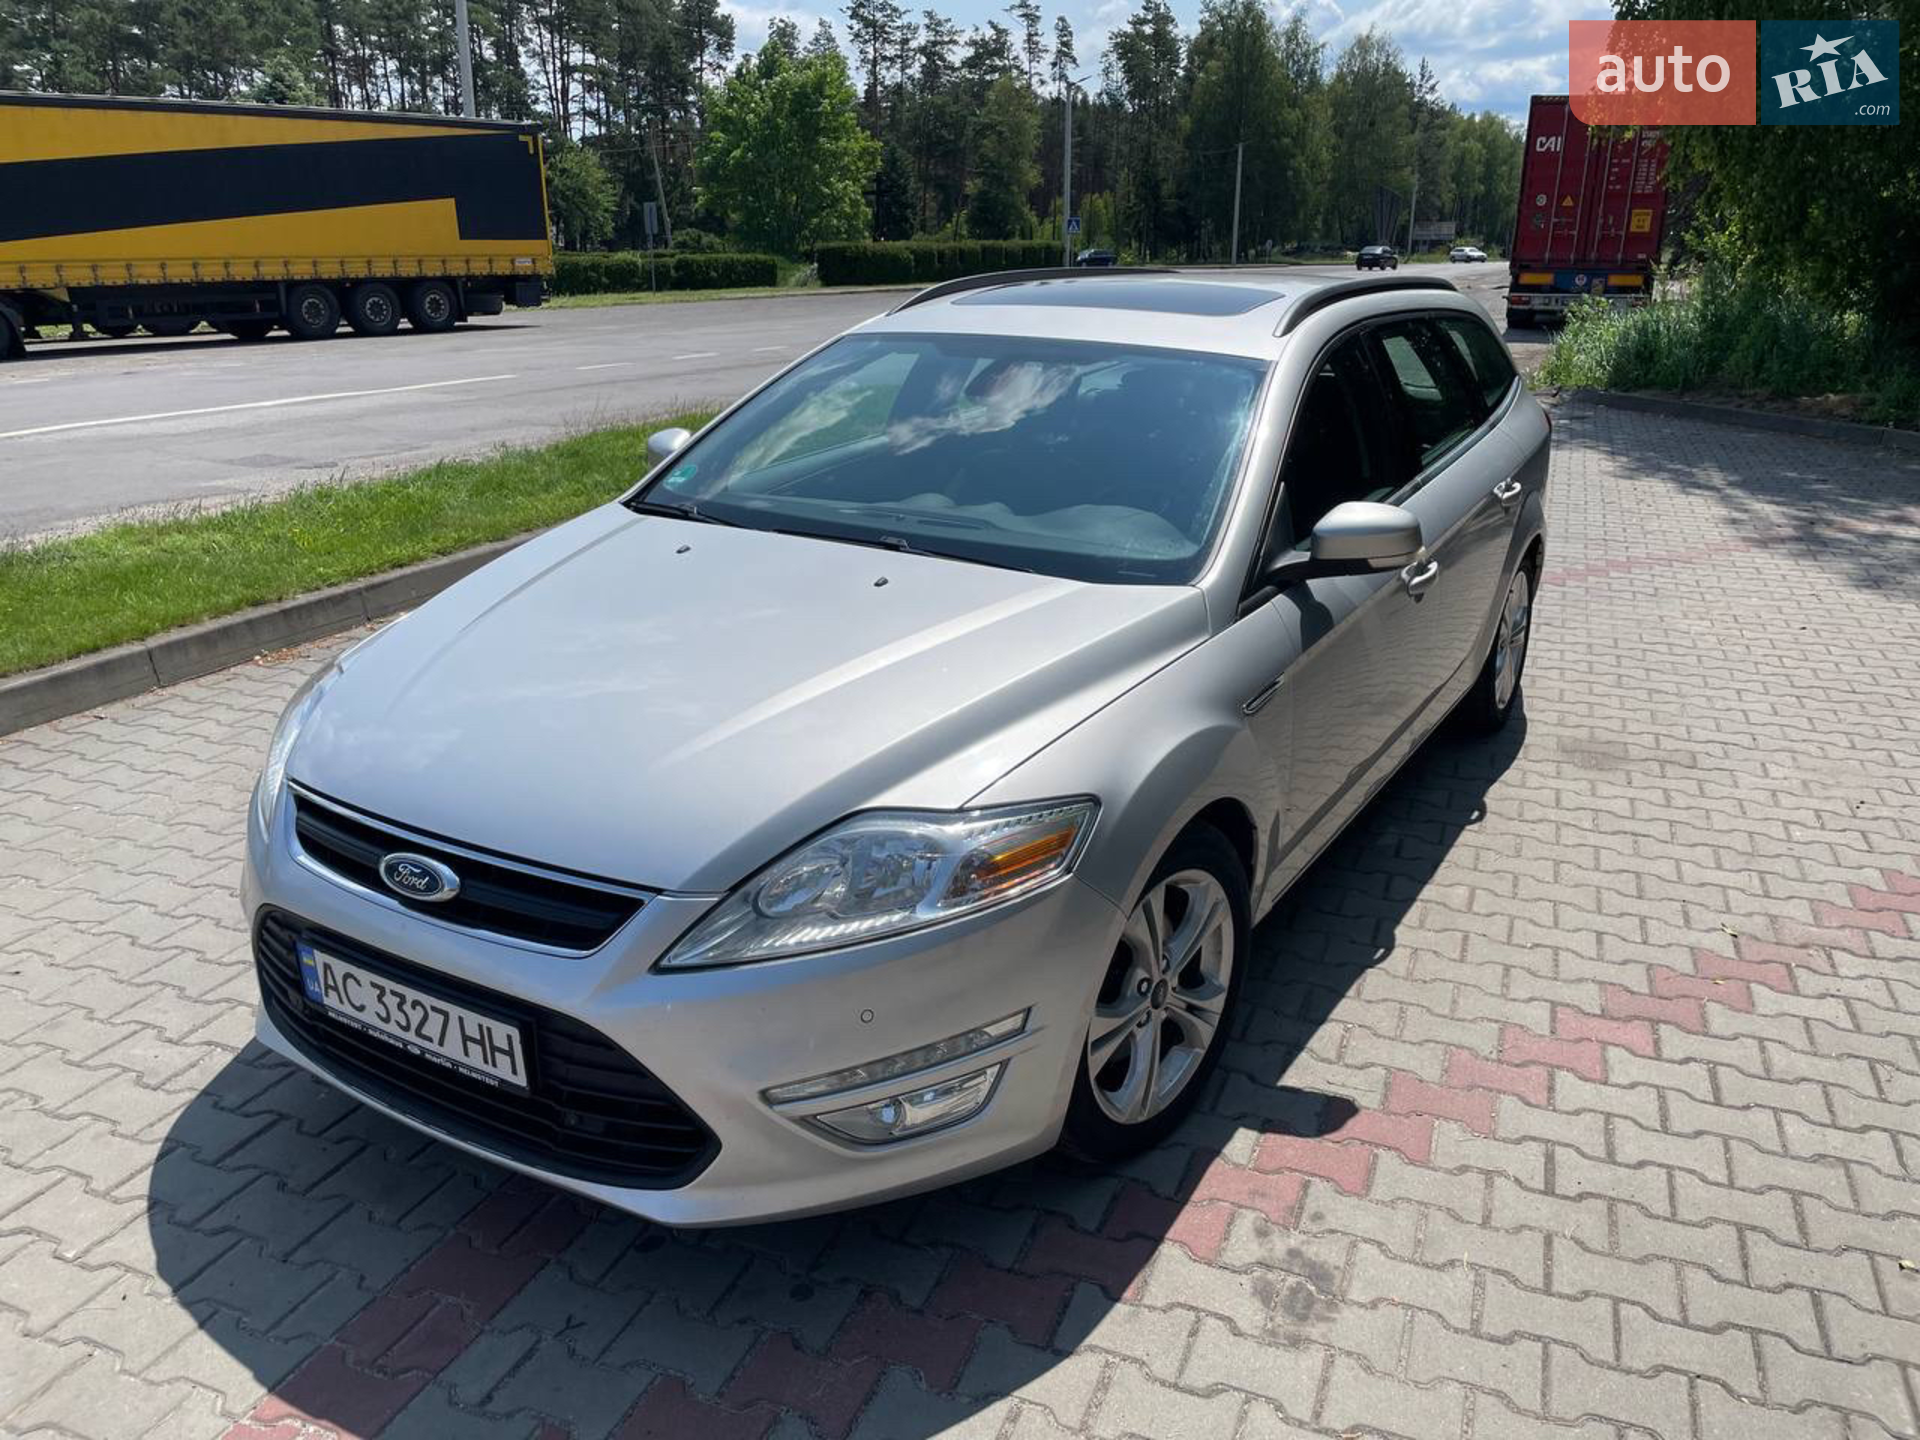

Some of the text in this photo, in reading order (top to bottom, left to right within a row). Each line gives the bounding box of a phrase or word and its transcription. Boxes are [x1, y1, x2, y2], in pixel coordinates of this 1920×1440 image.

[1535, 136, 1562, 152] CAI
[394, 863, 430, 891] Ford
[307, 977, 321, 993] UA
[323, 961, 518, 1076] AC 3327 HH
